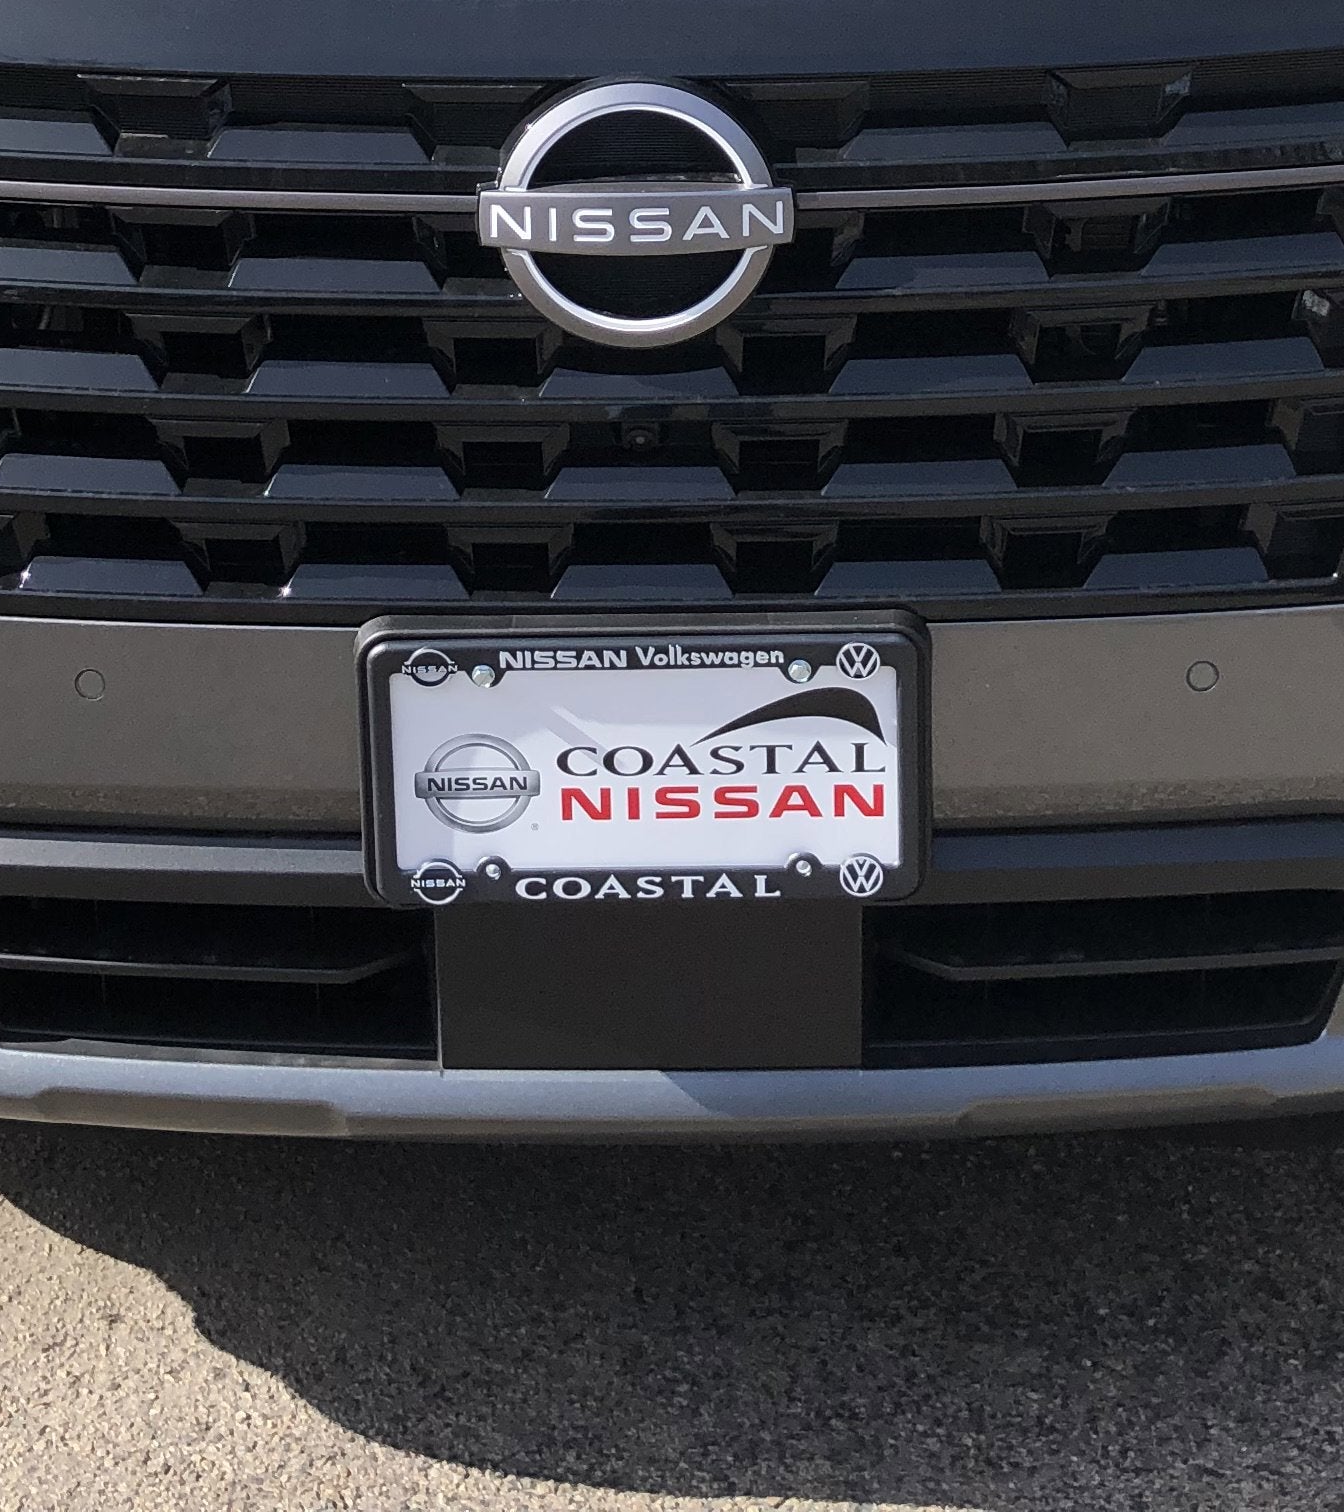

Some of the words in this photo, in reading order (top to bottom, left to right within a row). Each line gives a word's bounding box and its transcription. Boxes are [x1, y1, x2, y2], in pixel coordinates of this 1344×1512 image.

[489, 200, 784, 243] NISSAN
[401, 664, 458, 674] NISSAN
[499, 649, 628, 669] NISSAN
[635, 644, 785, 669] Volkswagen
[556, 740, 887, 777] COASTAL
[427, 776, 528, 792] NISSAN
[561, 784, 885, 821] NISSAN
[410, 877, 466, 889] NISSAN
[515, 873, 781, 900] COASTAL
